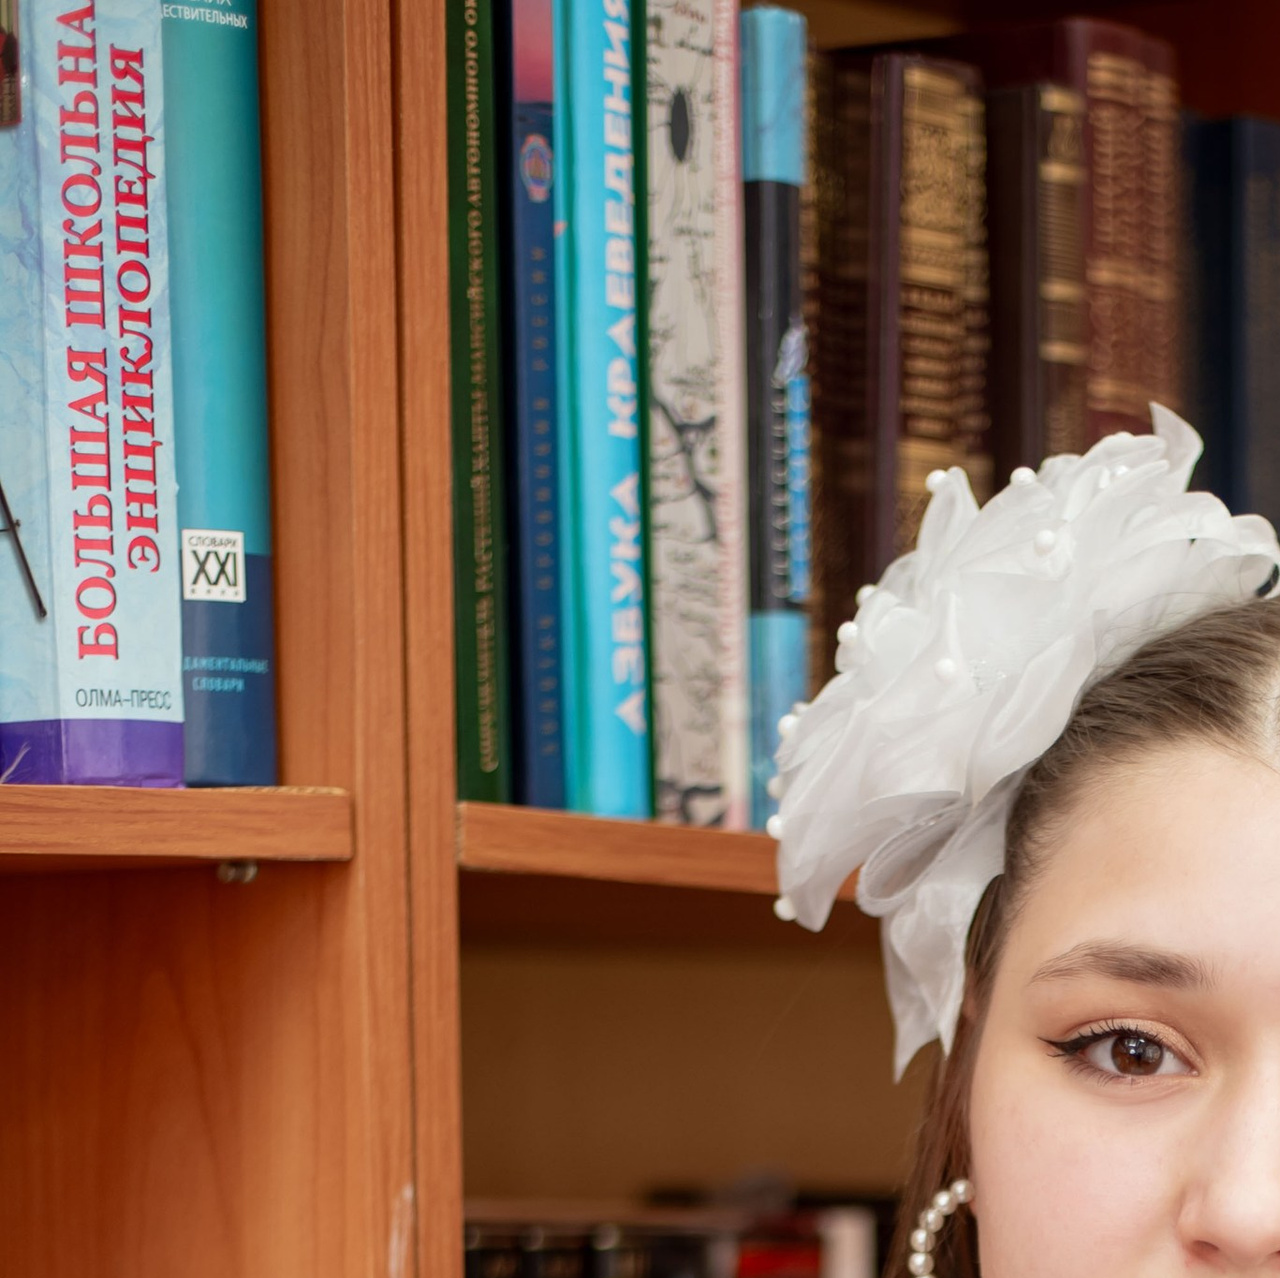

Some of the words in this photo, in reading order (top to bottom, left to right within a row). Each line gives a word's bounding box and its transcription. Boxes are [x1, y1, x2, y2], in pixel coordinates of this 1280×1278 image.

[160, 4, 248, 28] ЕСТВИТЕЛЬНЫХ
[465, 29, 482, 208] АВТОНОМНОГО
[56, 0, 105, 330] ШКОЛЬНА
[603, 0, 638, 440] КРАЕВЕДЕНИЯ
[109, 43, 163, 573] ЭНЦИКЛОПЕДИЯ
[67, 346, 118, 660] БОЛЬШАЯ
[191, 550, 238, 588] XXI
[607, 471, 647, 735] АЗБУКА
[75, 688, 172, 710] ОЛМА-ПРЕСС
[184, 656, 269, 675] ДАМЕНТАЛЬНЫЕ
